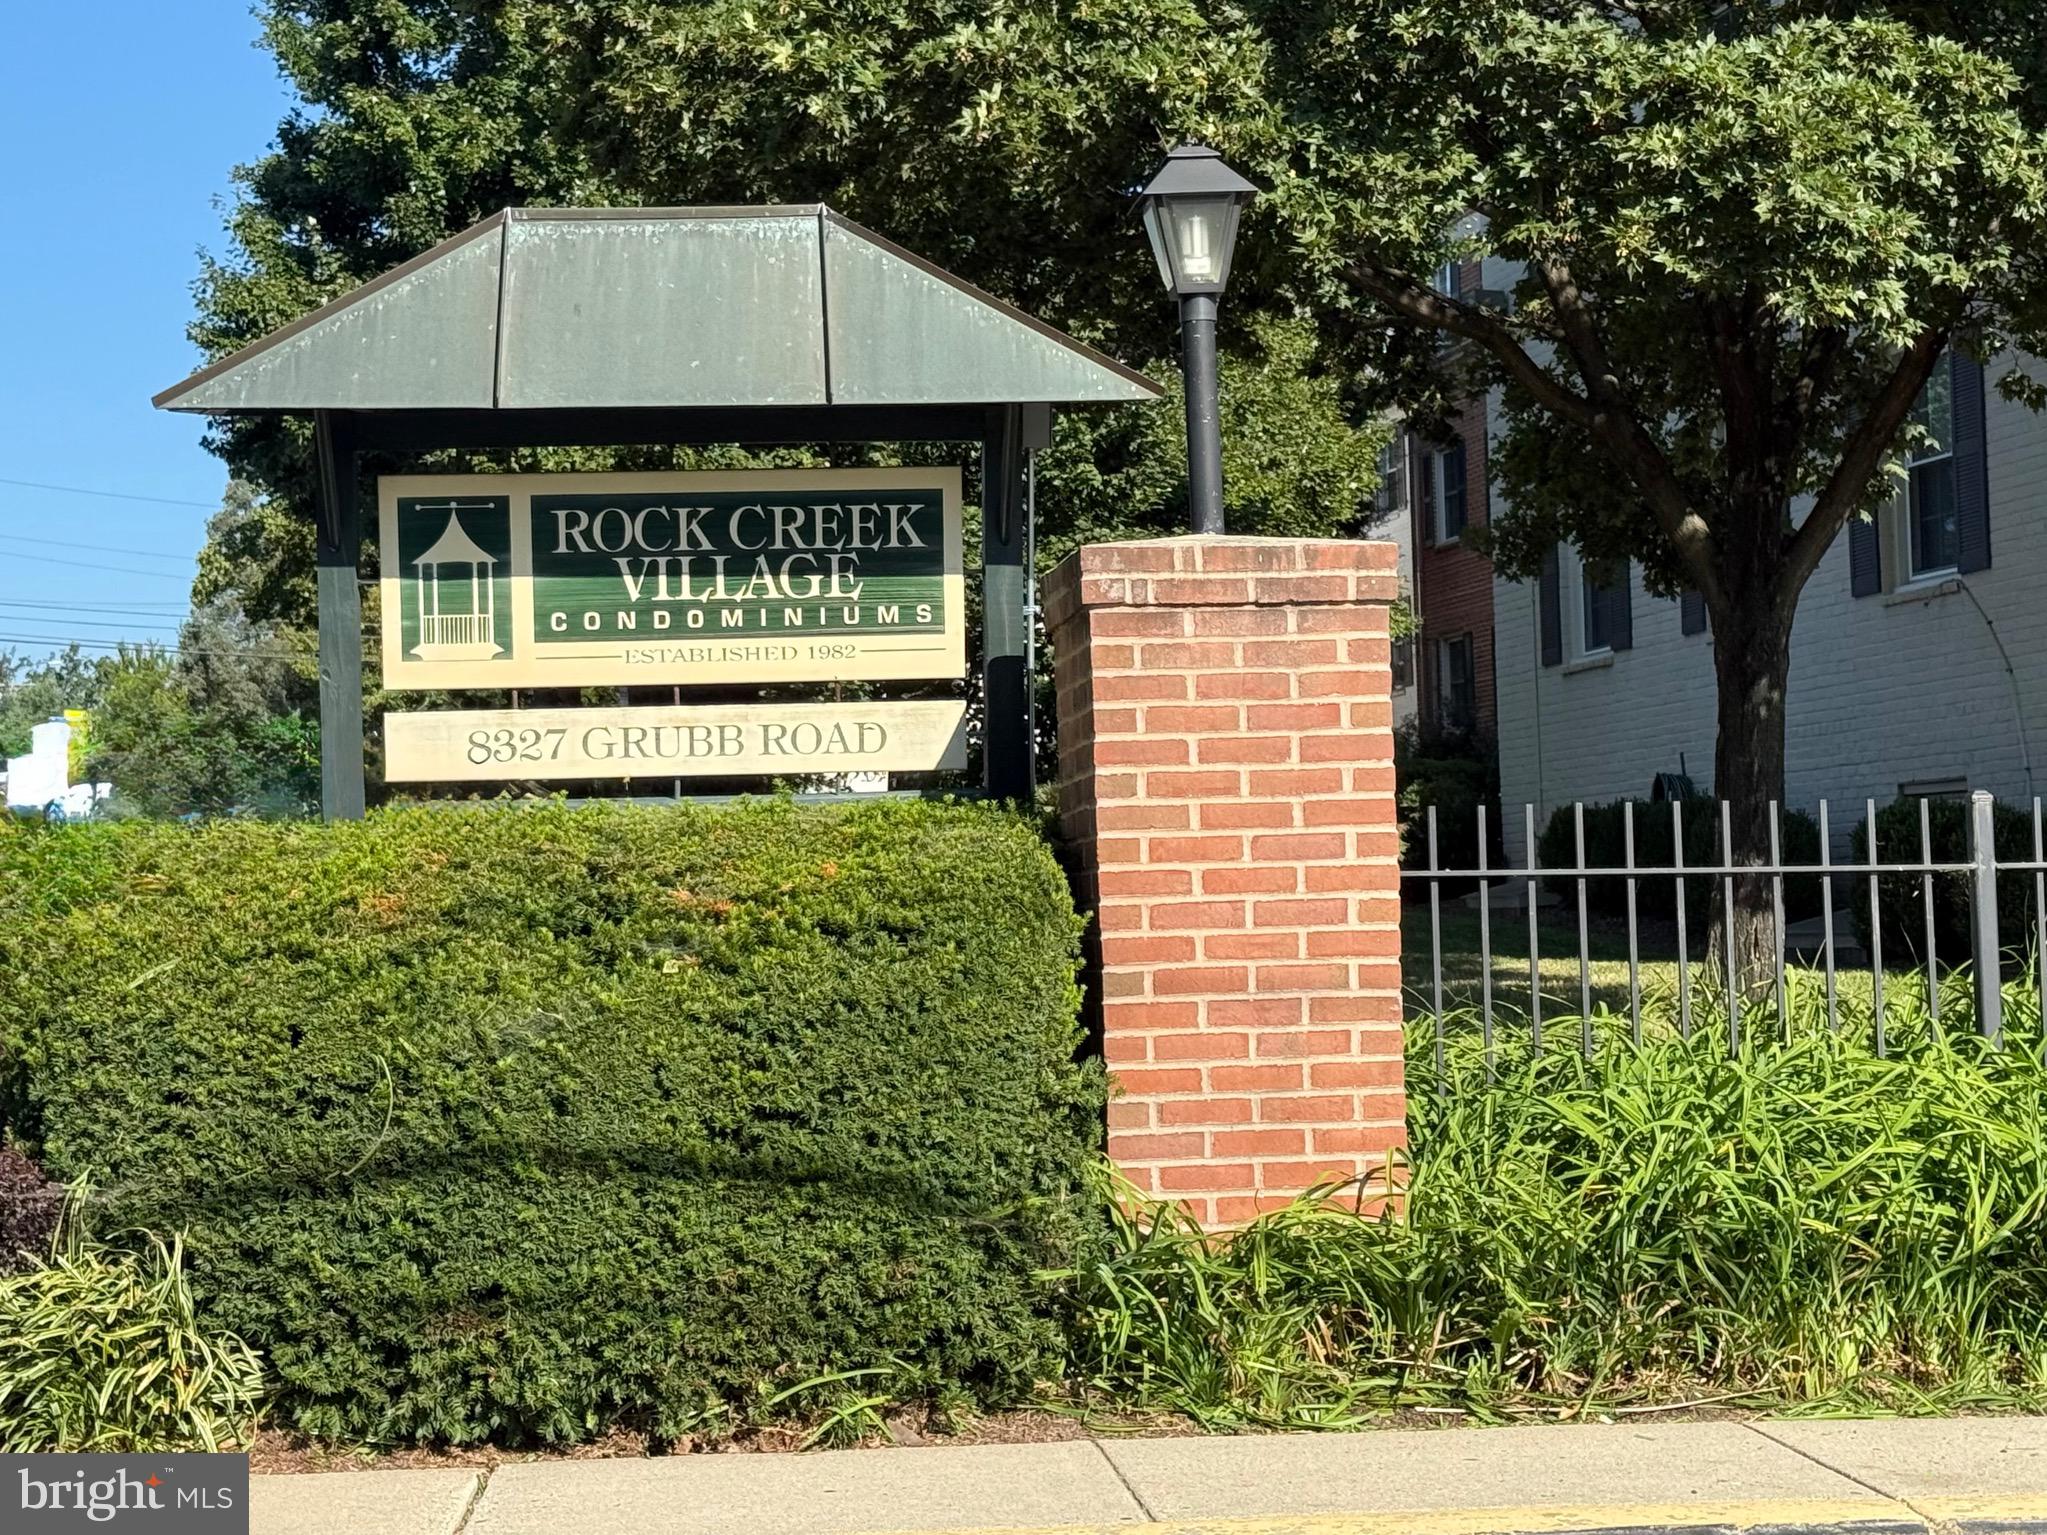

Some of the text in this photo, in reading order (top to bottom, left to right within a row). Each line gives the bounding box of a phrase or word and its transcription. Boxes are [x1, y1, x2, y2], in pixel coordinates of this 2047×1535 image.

[550, 502, 928, 553] ROCK CREEK
[612, 551, 864, 604] VILLAGE
[551, 604, 932, 632] CONDOMINIUMS
[625, 644, 856, 664] ESTABLISHED 1982
[467, 722, 887, 764] 8327 GRUBB ROAD
